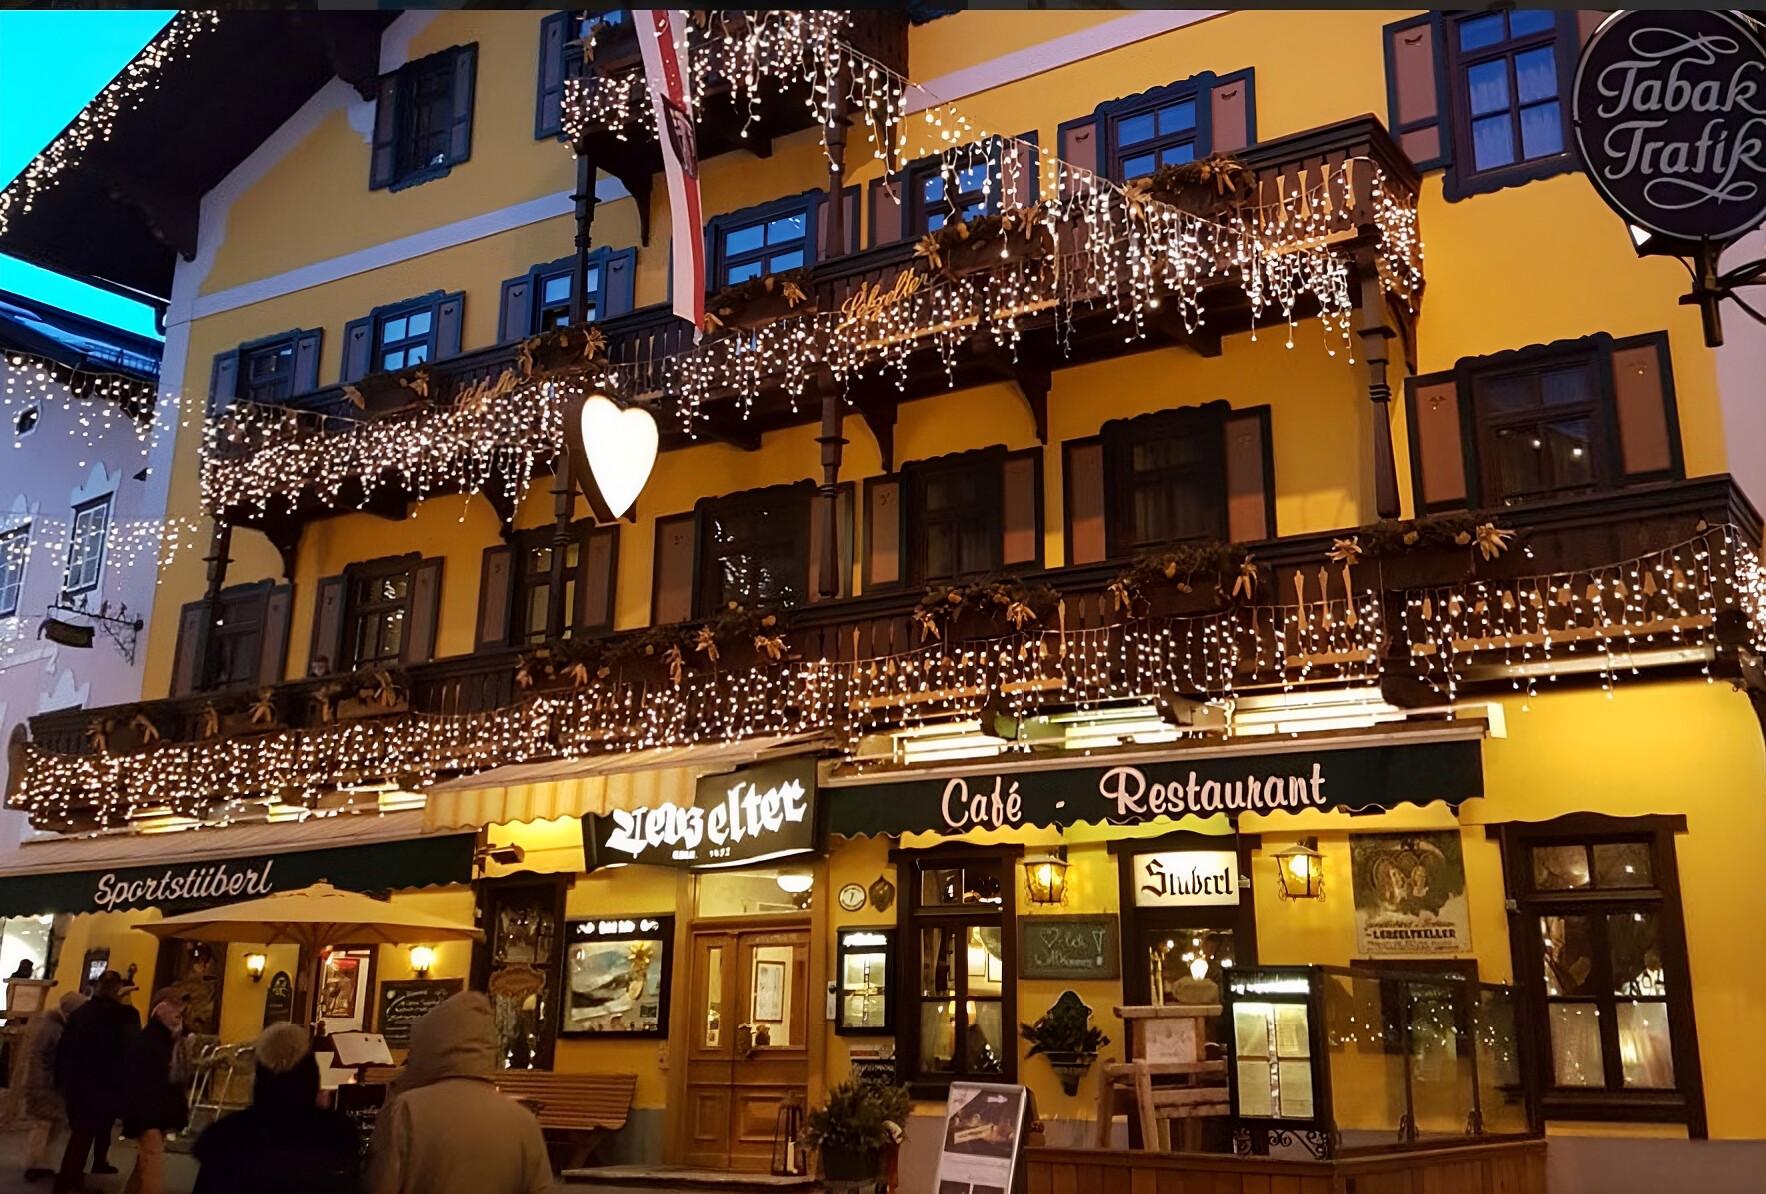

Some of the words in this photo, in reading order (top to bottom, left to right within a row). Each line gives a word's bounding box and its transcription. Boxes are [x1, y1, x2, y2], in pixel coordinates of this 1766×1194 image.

[1597, 54, 1766, 118] Tabak
[1603, 118, 1766, 186] Trafik
[941, 776, 1022, 828] Café
[1100, 763, 1327, 816] Restaurant
[94, 860, 273, 911] Sportstüberl
